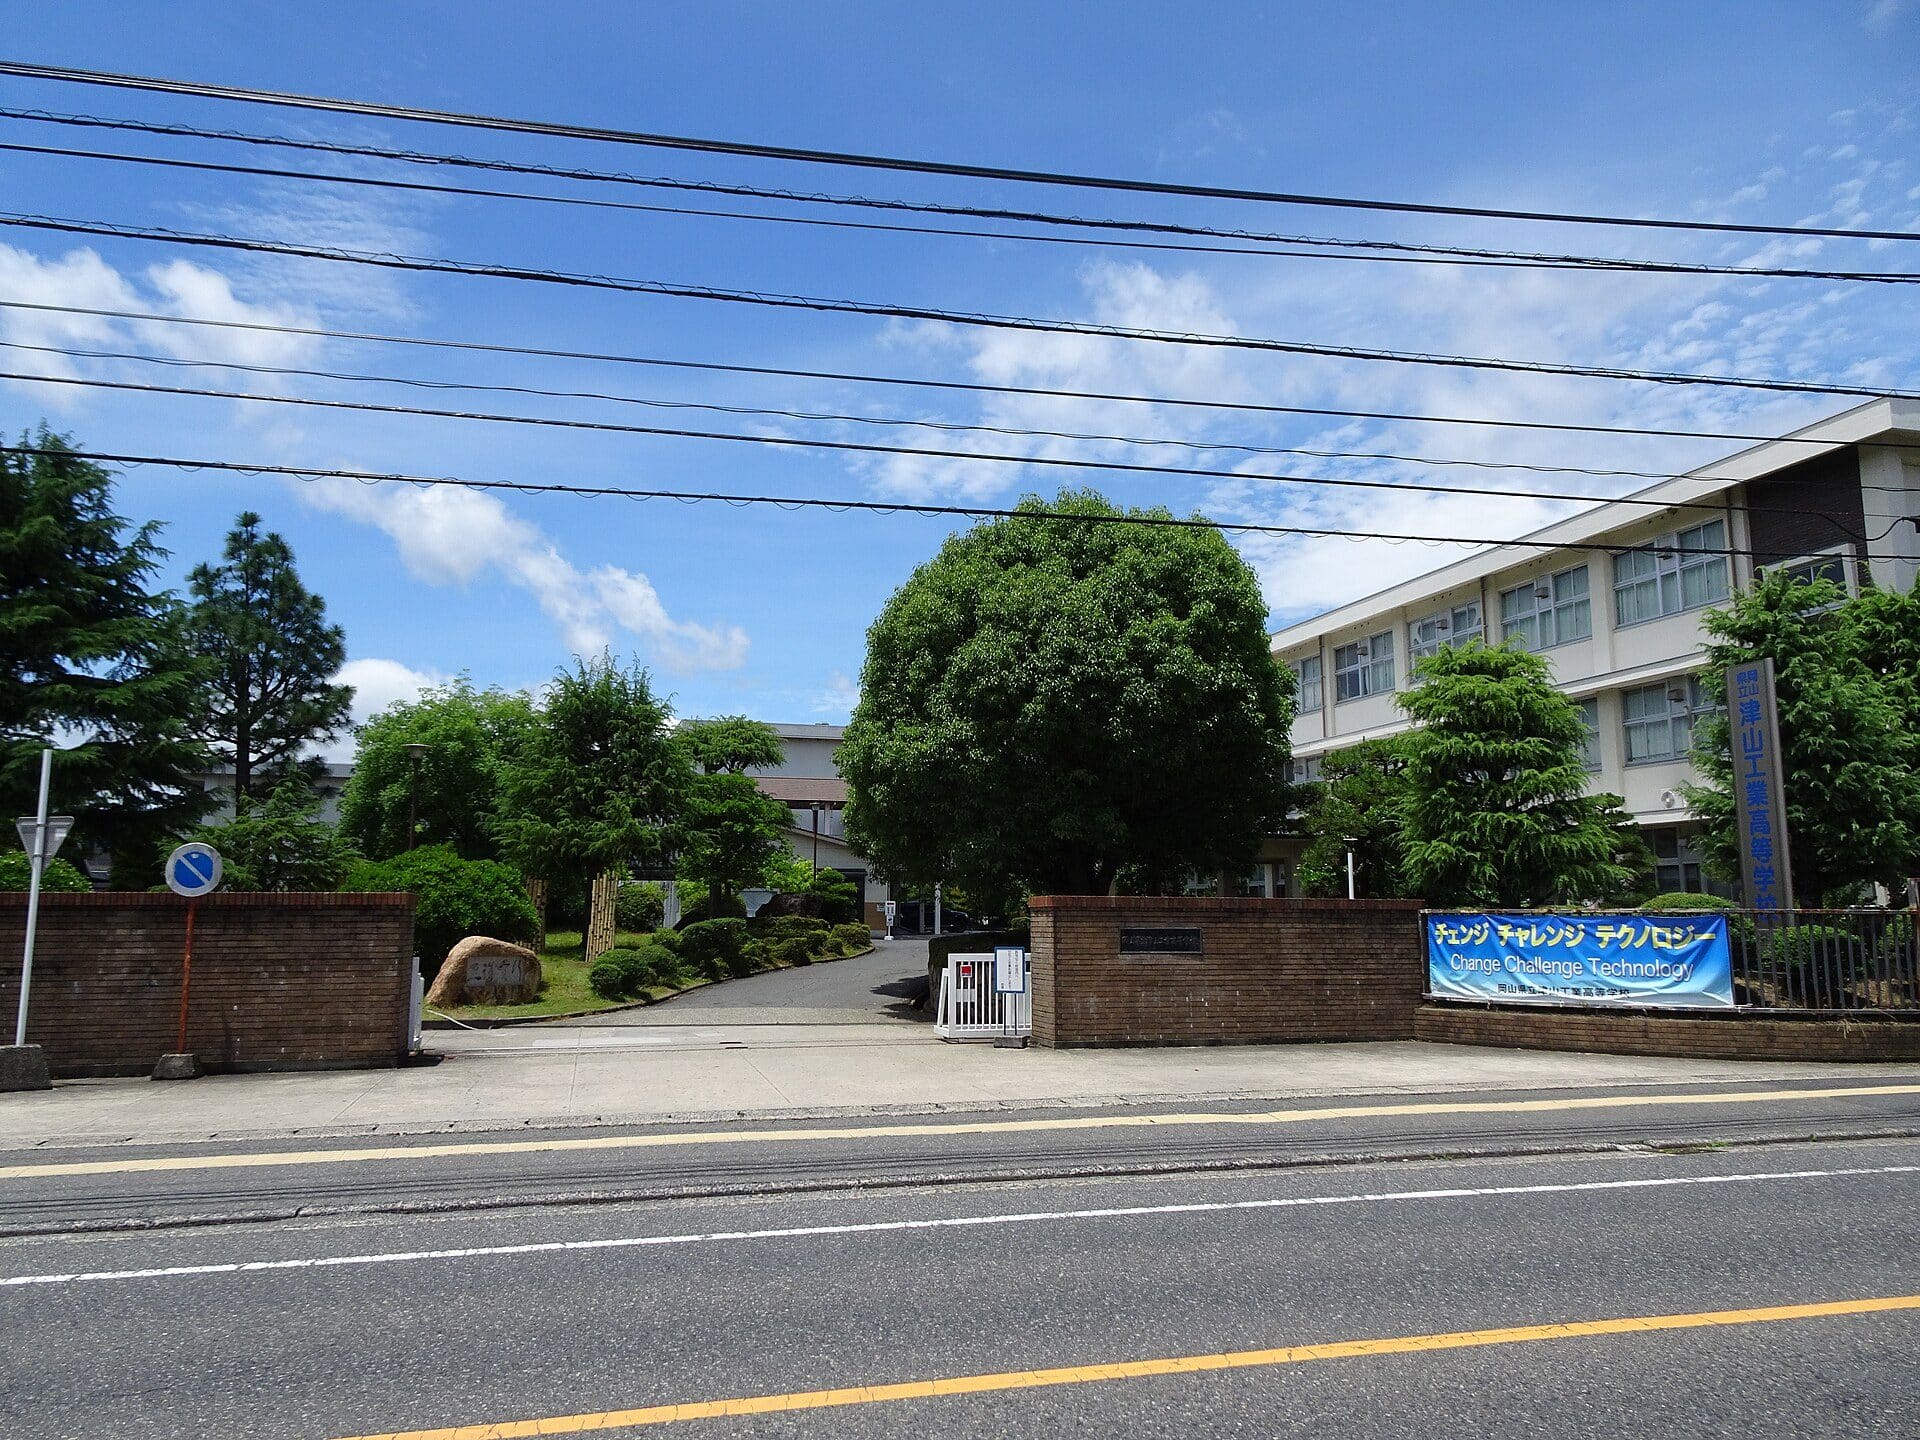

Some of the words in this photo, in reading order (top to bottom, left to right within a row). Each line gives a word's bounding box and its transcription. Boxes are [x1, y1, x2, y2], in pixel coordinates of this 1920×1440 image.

[1435, 922, 1489, 946] チェンジ
[1497, 923, 1585, 948] チャレンジ
[1596, 924, 1717, 950] テクノロジー
[1450, 953, 1501, 976] Change
[1504, 955, 1583, 979] Challenge
[1587, 957, 1694, 982] Technology
